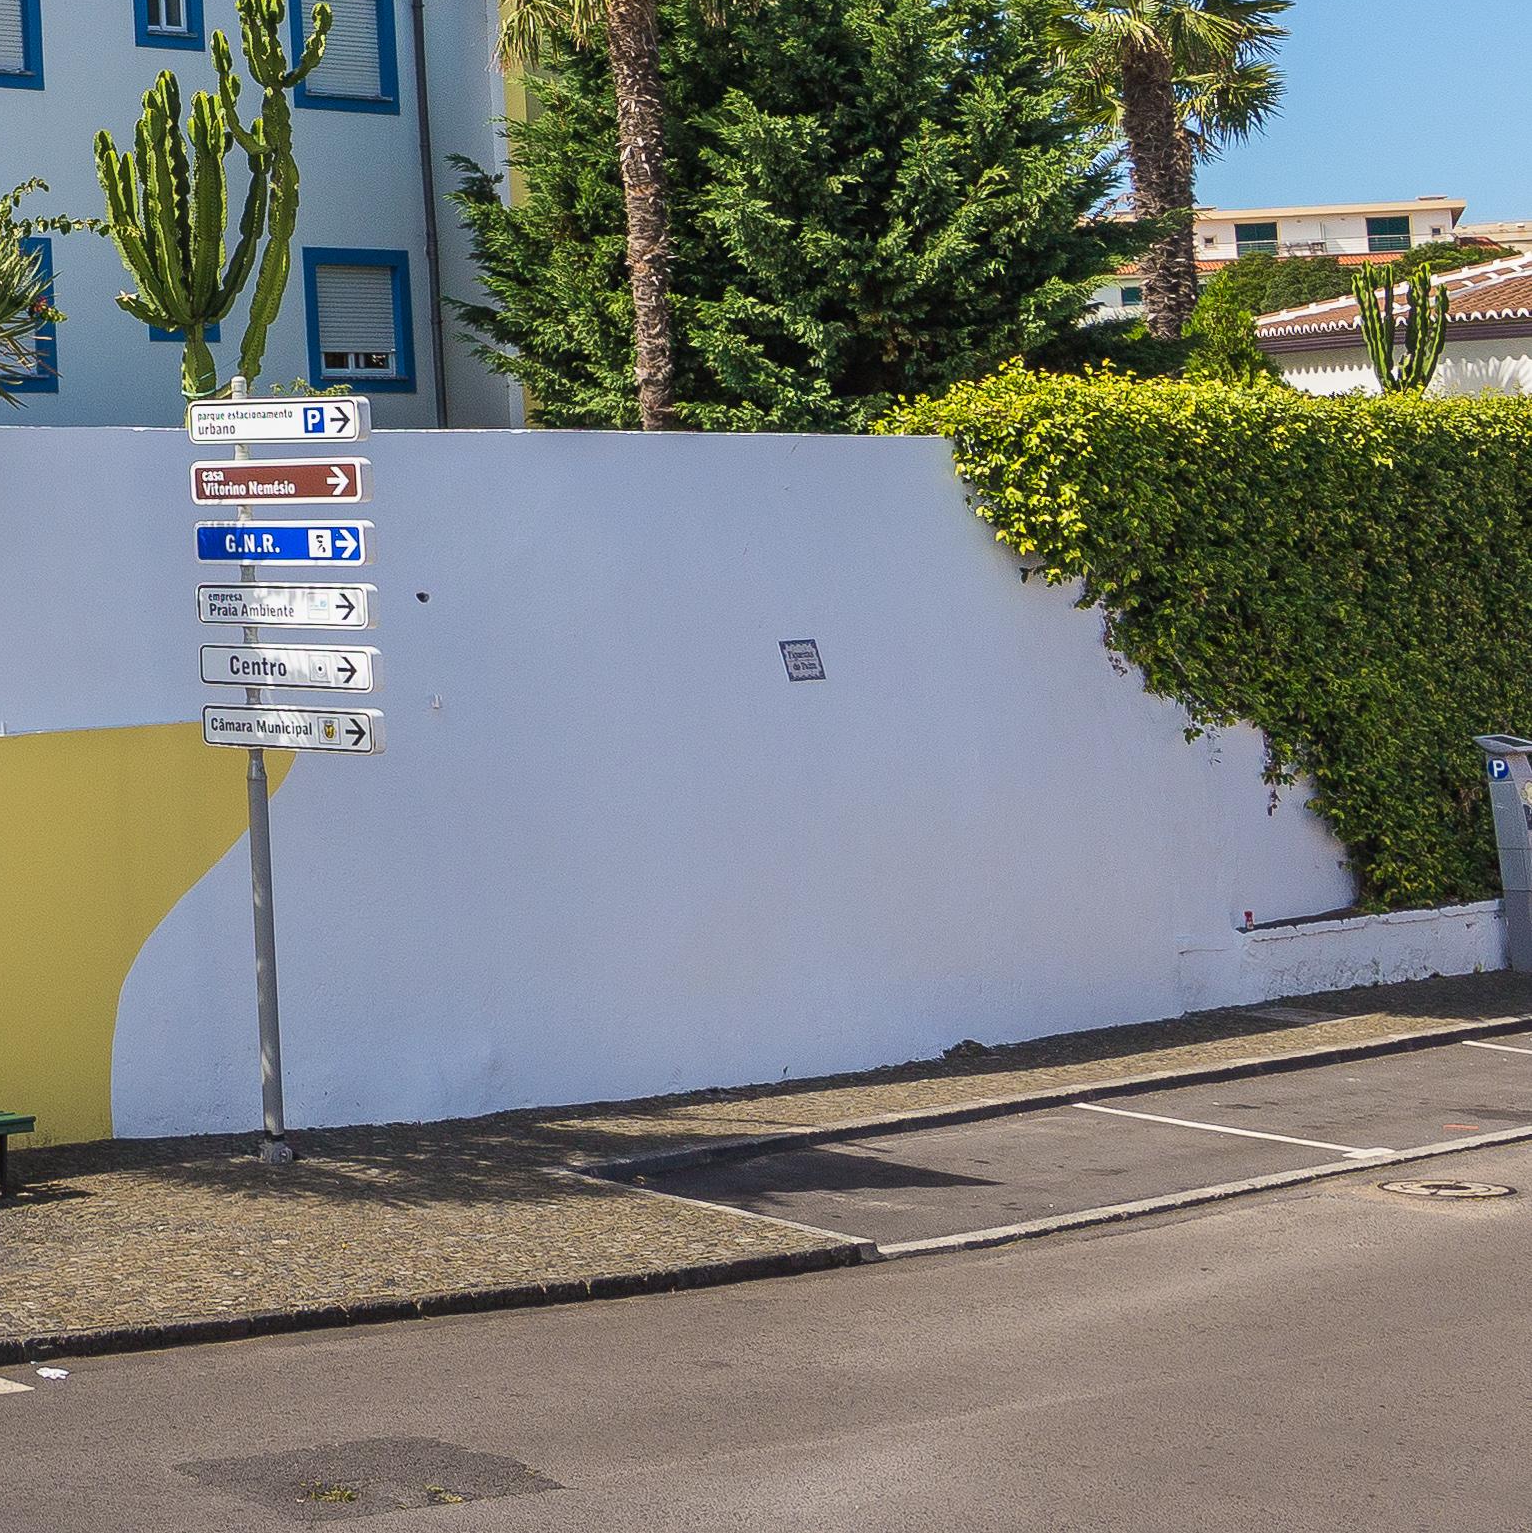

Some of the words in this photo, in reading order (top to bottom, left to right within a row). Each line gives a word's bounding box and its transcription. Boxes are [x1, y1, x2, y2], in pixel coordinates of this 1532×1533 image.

[197, 411, 225, 423] parque
[227, 408, 294, 420] estacionamento
[306, 409, 321, 431] P
[198, 423, 236, 435] urbano
[201, 469, 225, 482] casa
[202, 481, 247, 496] Vitorino
[248, 479, 296, 496] Nemésio
[225, 533, 281, 553] G.N.R.
[208, 592, 243, 603] empresa
[209, 603, 238, 617] Praia
[241, 603, 295, 618] Ambiente
[229, 655, 287, 677] Centro
[211, 717, 253, 733] Câmara
[256, 720, 313, 738] Municipal
[1492, 759, 1506, 778] P
